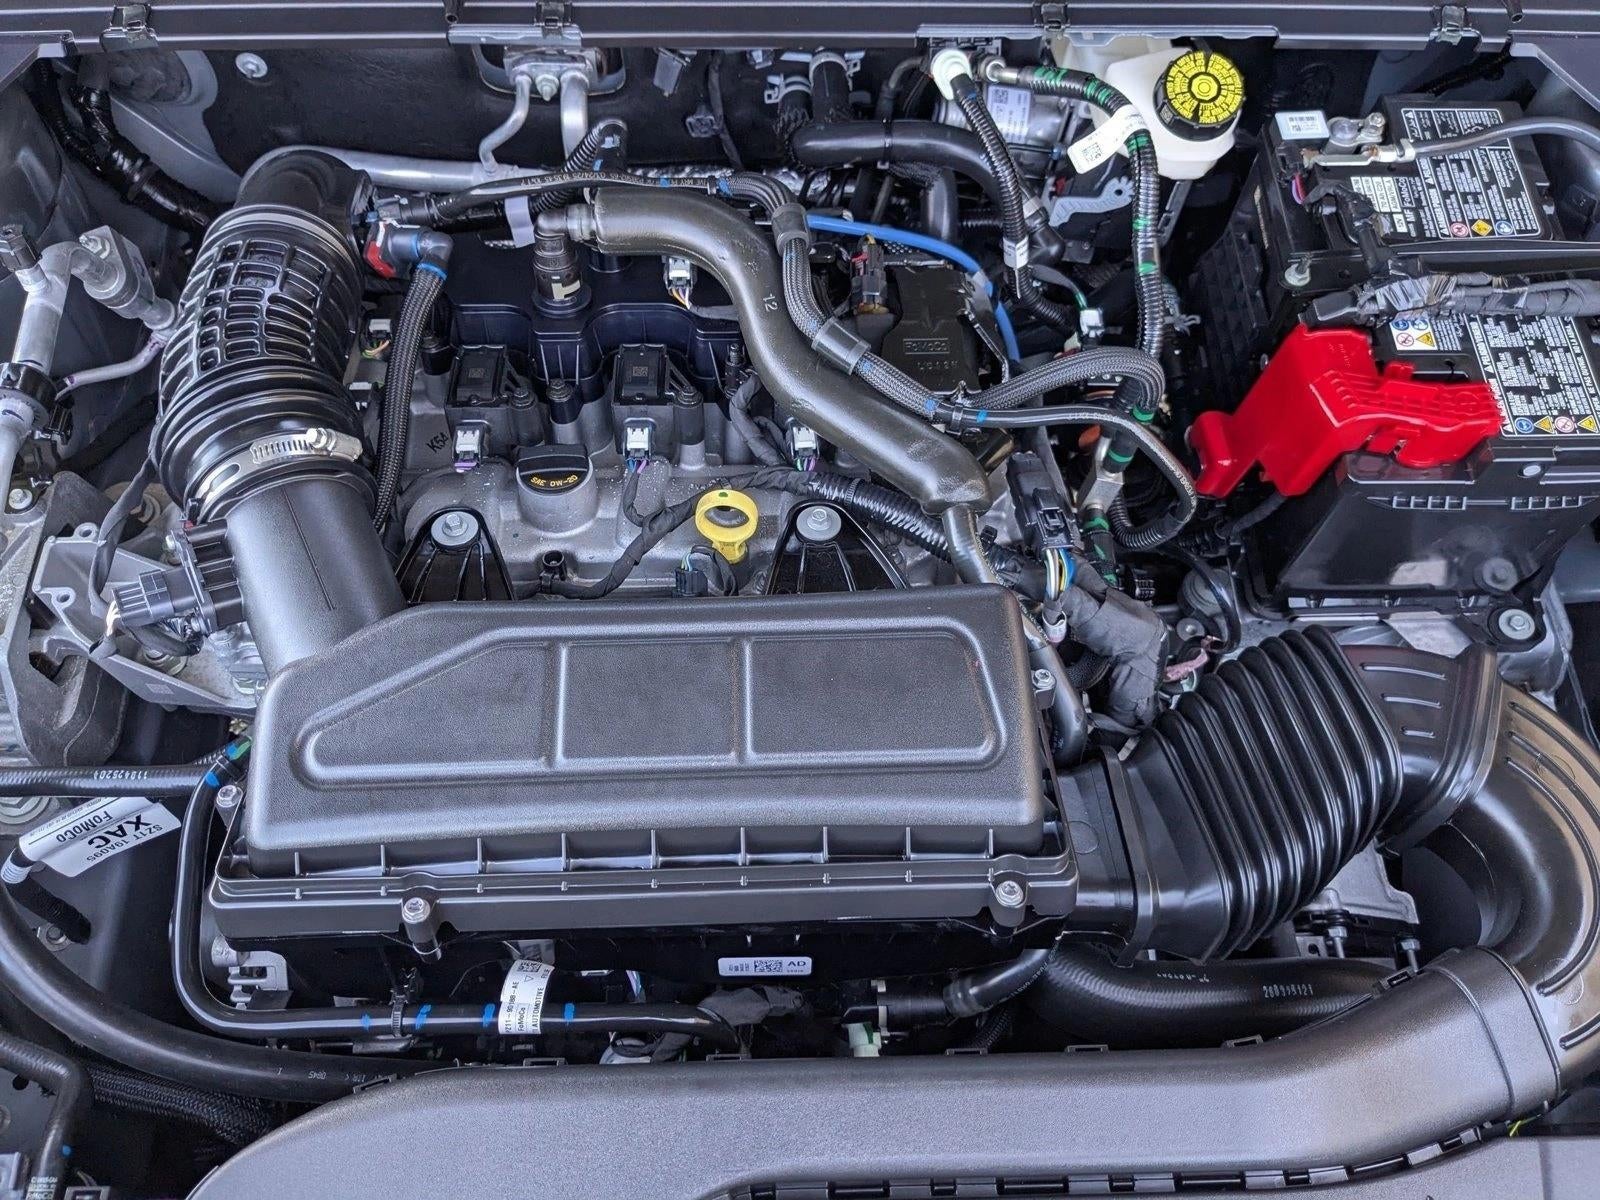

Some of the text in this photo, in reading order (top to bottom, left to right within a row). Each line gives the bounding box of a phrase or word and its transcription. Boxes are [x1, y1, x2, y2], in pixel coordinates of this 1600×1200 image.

[1399, 178, 1412, 207] FoMoCo
[530, 476, 547, 487] SAE
[56, 810, 114, 843] FoMoCo
[87, 814, 151, 849] XAC
[86, 840, 130, 862] 19A095
[517, 1007, 526, 1032] FoMoCo
[532, 987, 545, 1028] AUTOMOTIVE
